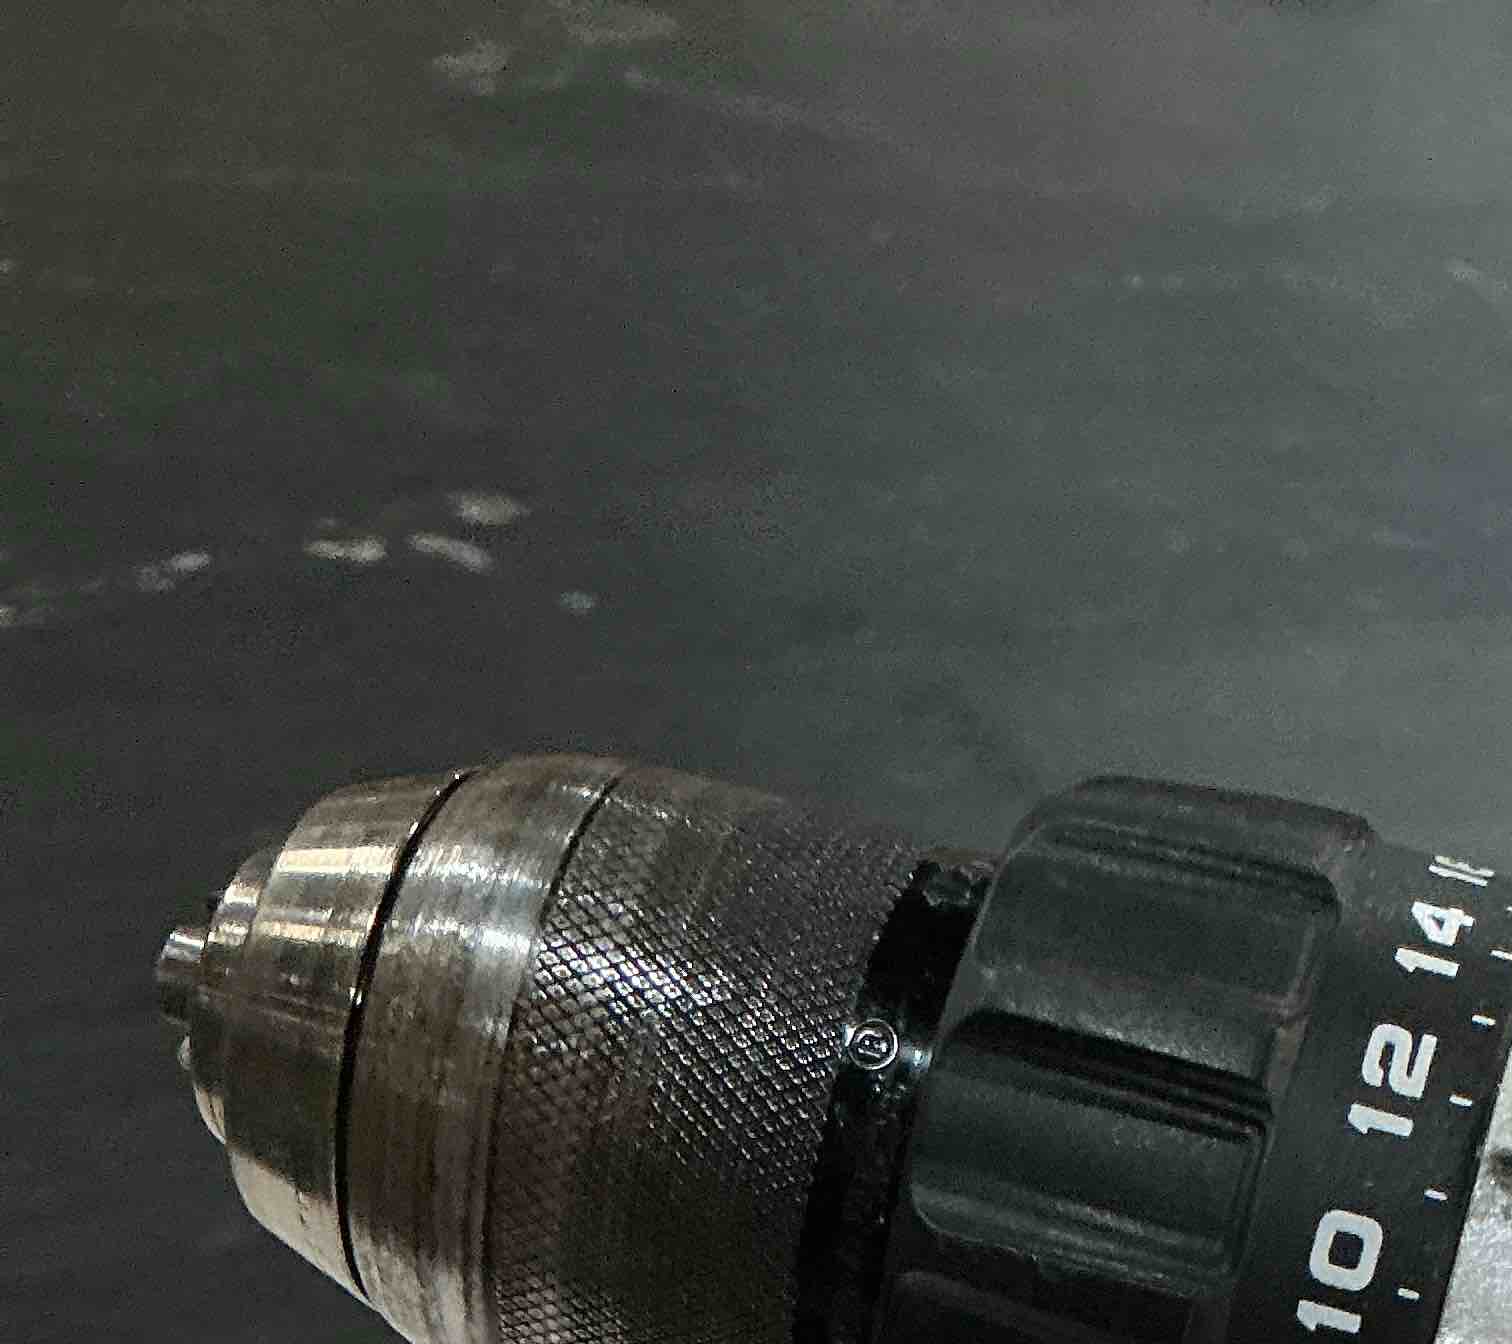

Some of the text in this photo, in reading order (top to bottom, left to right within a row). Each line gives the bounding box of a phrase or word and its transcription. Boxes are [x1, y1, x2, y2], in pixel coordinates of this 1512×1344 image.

[1395, 900, 1476, 977] 14
[1348, 1023, 1438, 1137] 12
[1297, 1209, 1384, 1334] 10
